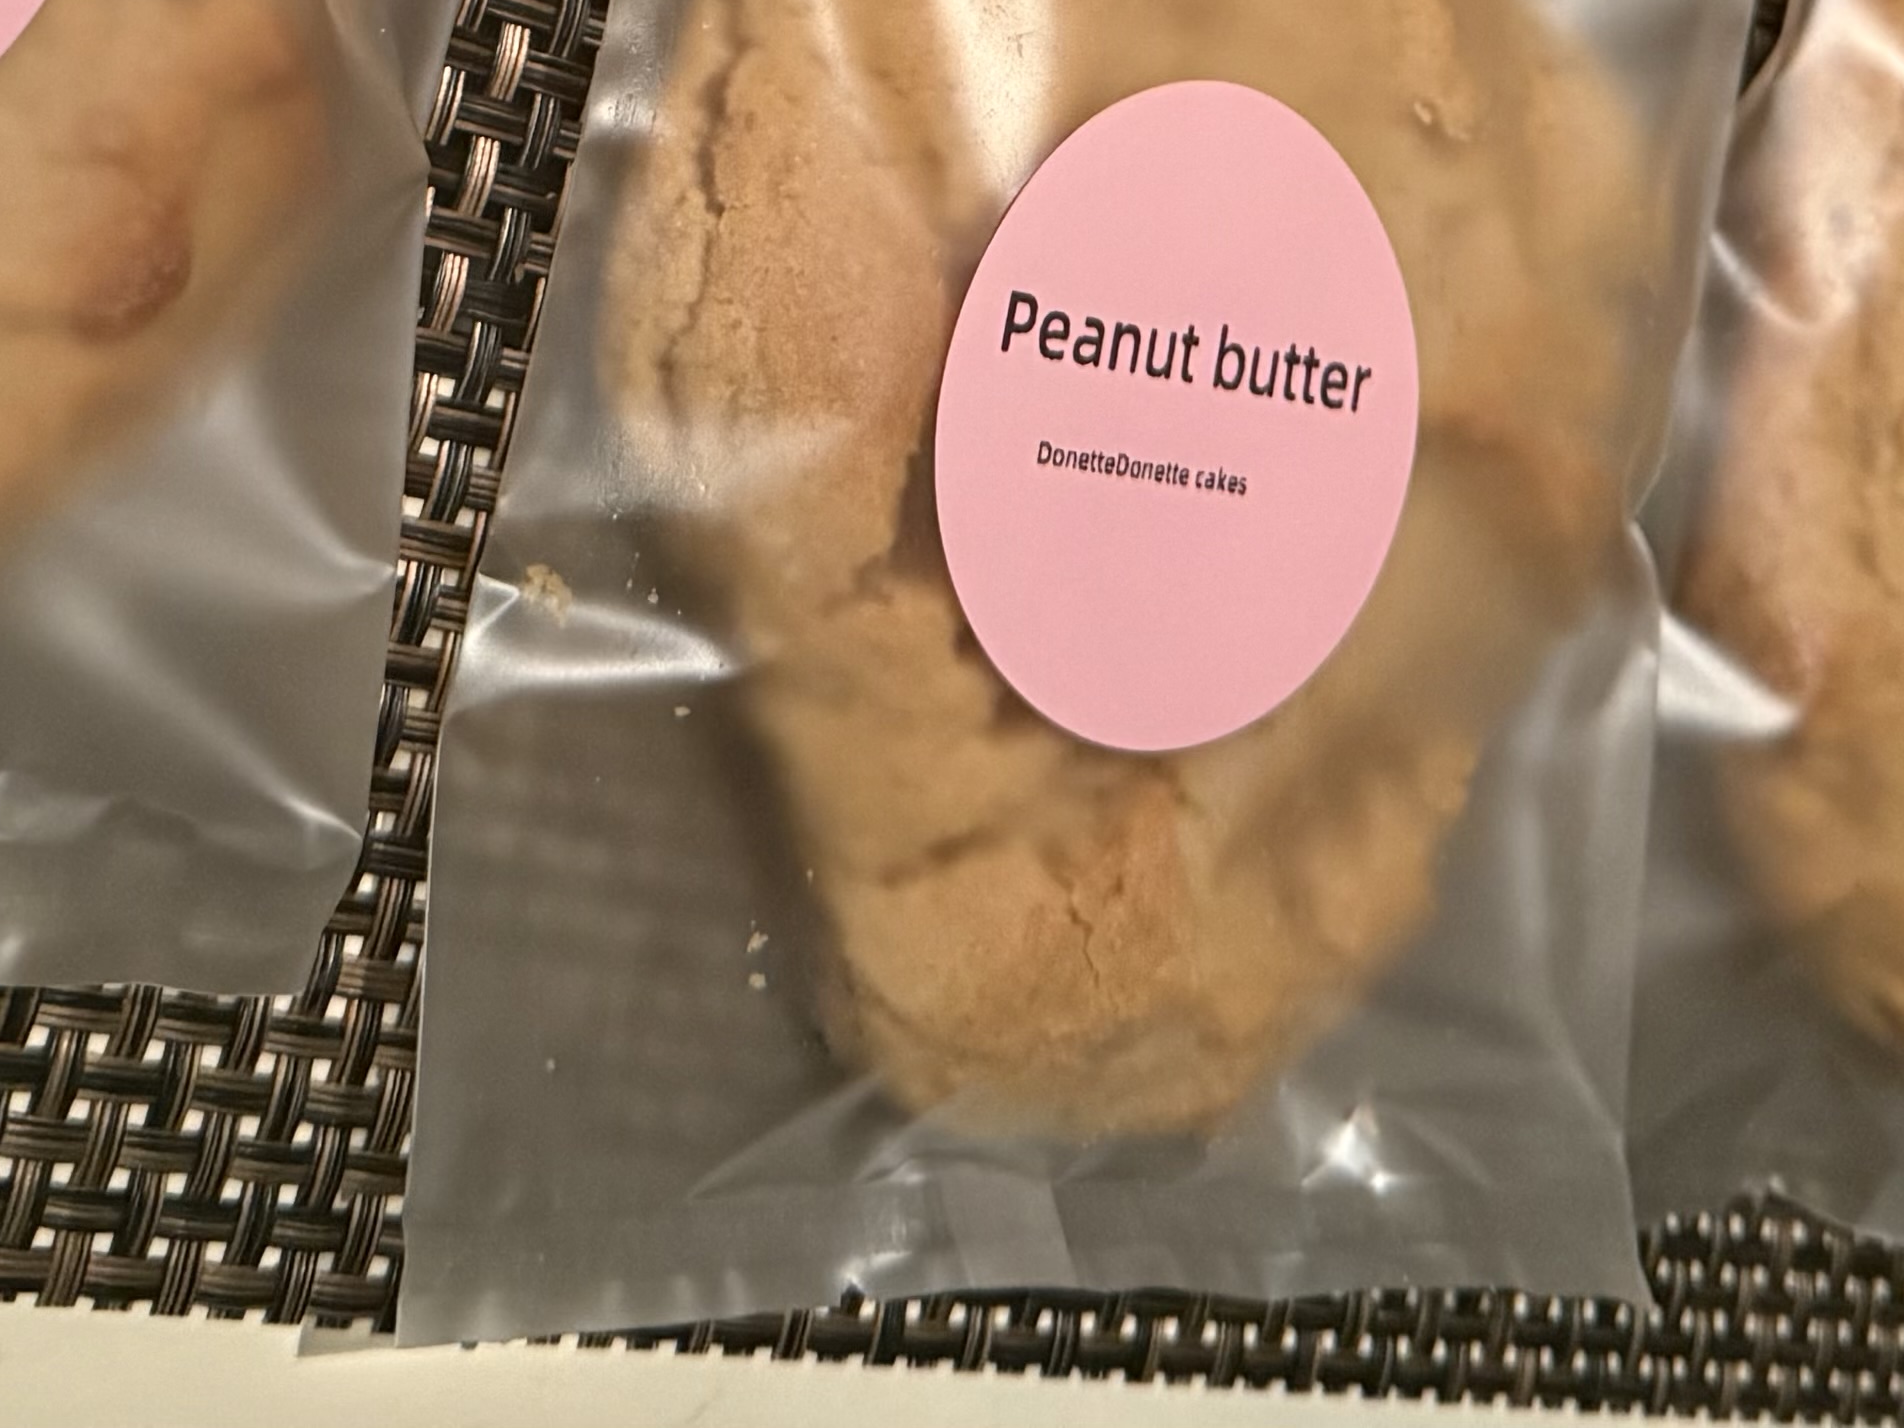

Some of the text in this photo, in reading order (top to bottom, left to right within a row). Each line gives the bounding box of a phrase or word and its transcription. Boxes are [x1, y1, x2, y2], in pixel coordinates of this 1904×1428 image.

[1001, 291, 1371, 412] Peanut butter
[1037, 441, 1246, 496] DonetteDonette cakes
